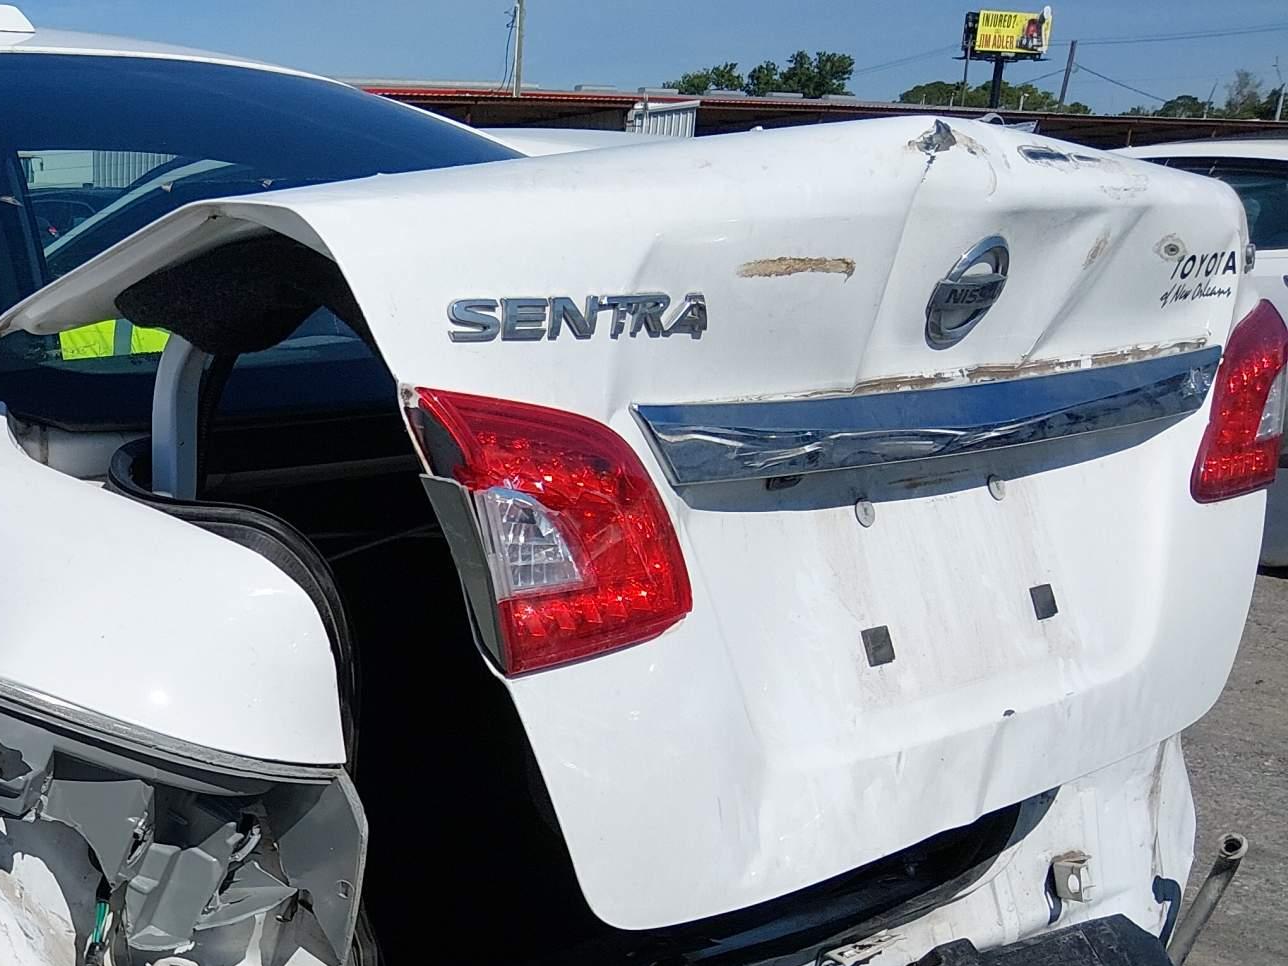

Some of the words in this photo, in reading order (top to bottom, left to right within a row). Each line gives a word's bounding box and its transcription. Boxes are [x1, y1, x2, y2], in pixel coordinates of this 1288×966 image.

[982, 13, 1018, 28] INJURED?
[978, 34, 991, 48] JIM
[992, 34, 1015, 49] ADLER
[1170, 251, 1237, 280] TOYOTA
[1160, 283, 1177, 308] of
[1169, 284, 1192, 304] New
[1192, 278, 1232, 300] Orleans
[447, 292, 708, 343] SENTRA
